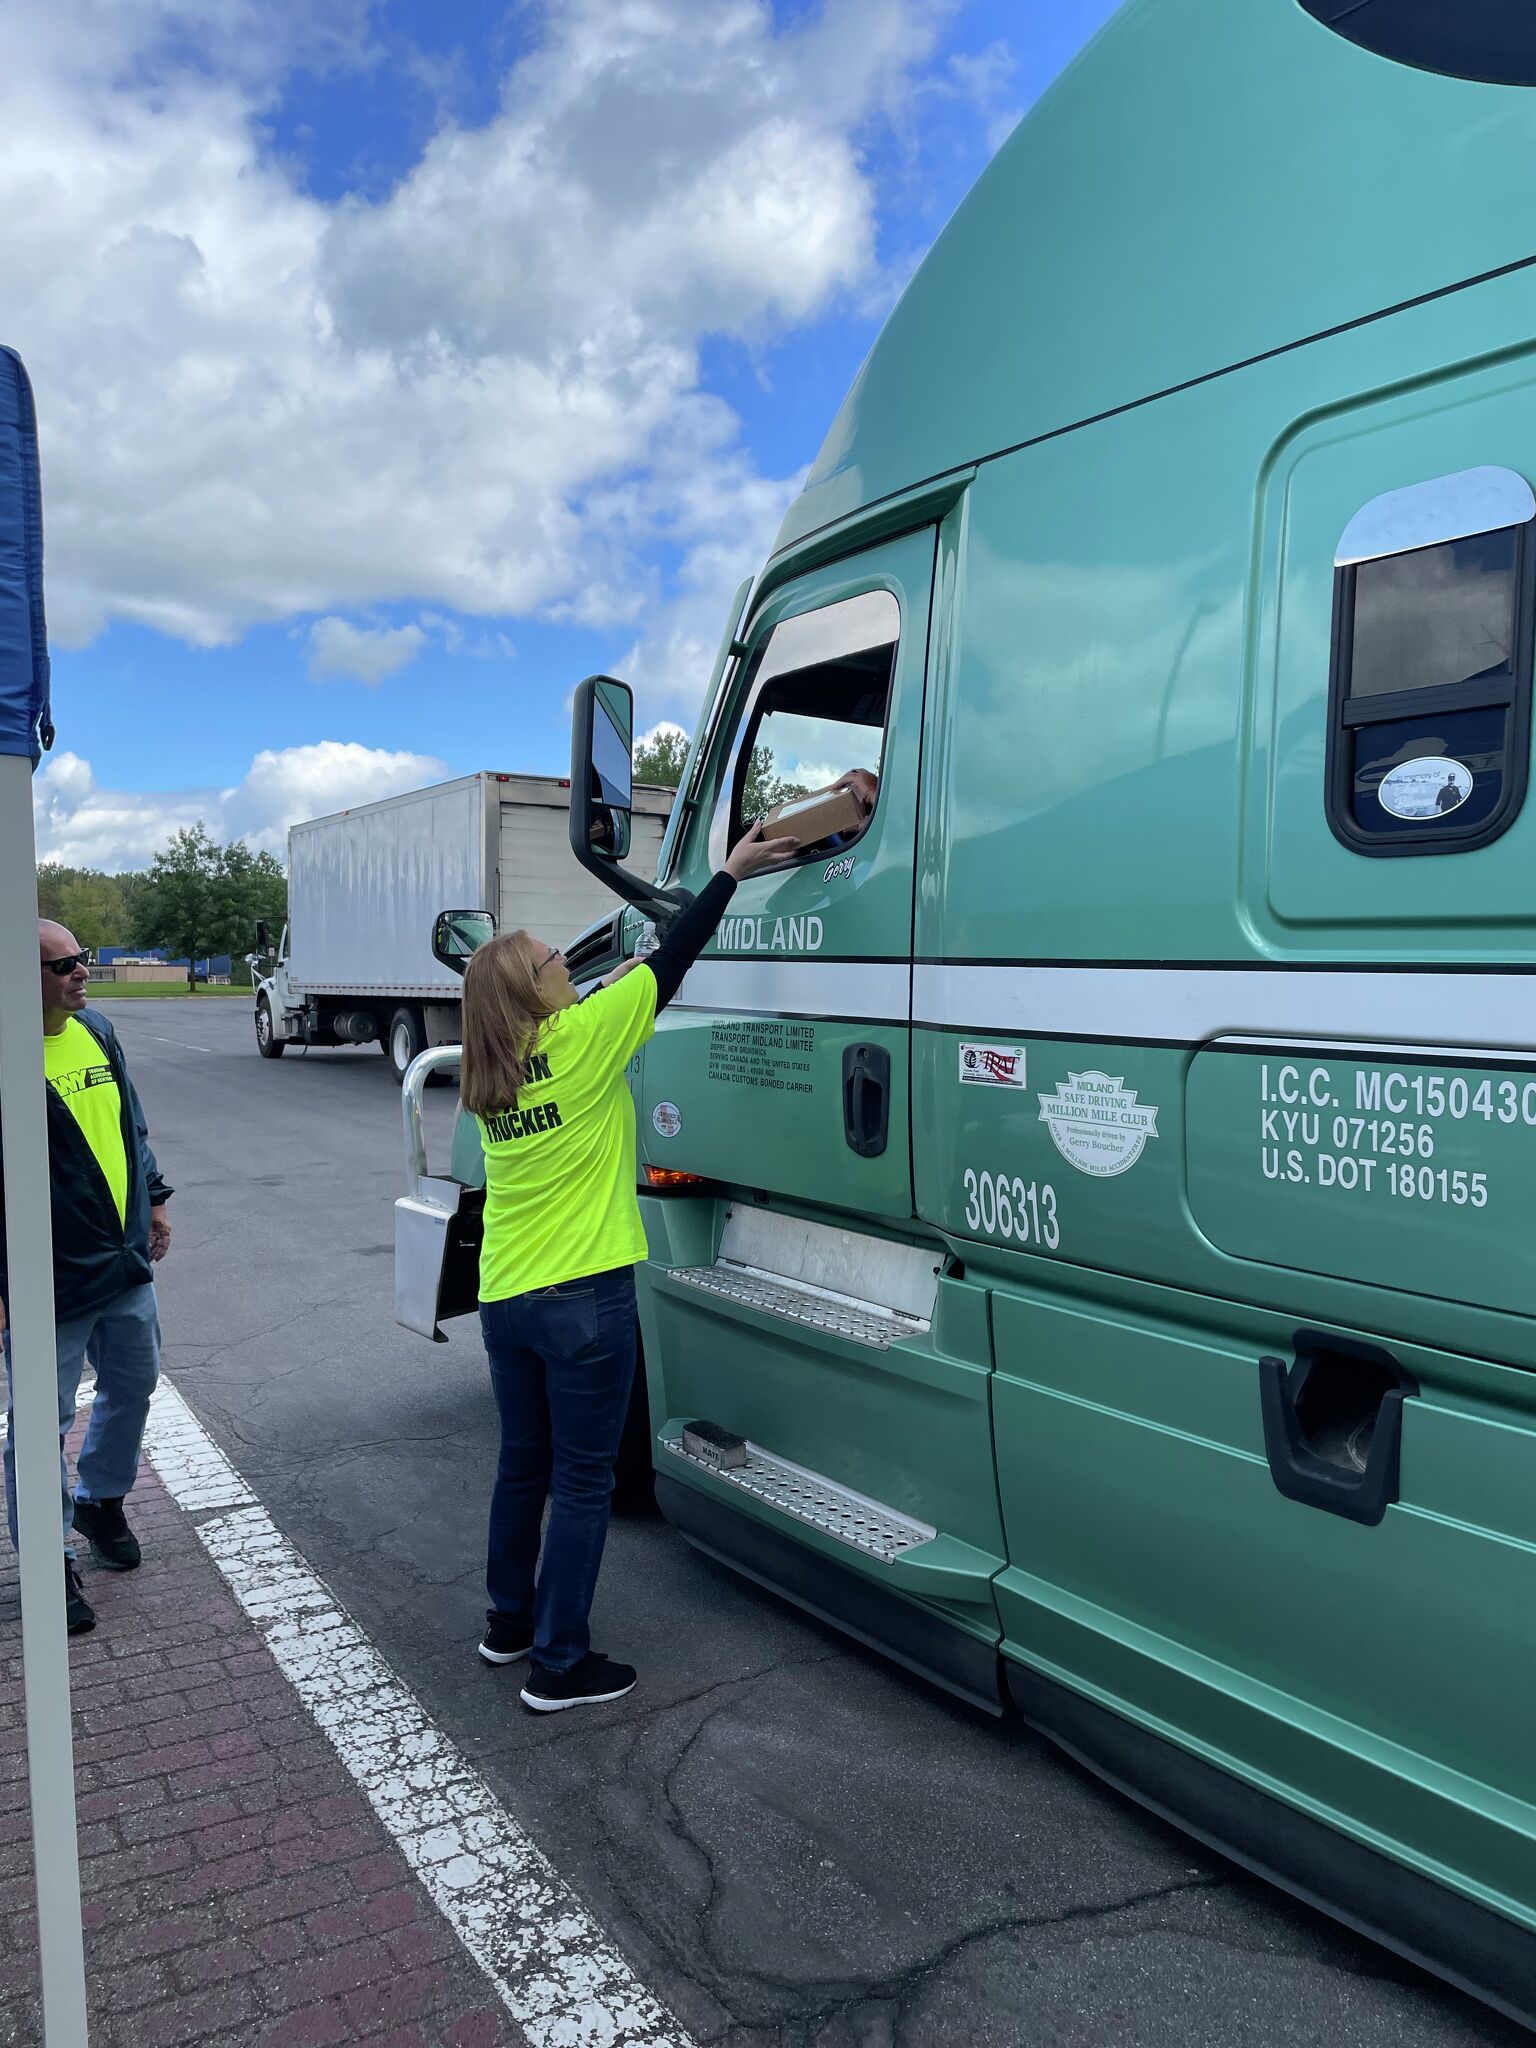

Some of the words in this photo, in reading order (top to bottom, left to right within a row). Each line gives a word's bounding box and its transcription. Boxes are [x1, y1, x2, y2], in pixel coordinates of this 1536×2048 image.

[717, 916, 824, 951] MIDLAND
[712, 1020, 741, 1032] MIDLAND
[742, 1022, 784, 1035] TRANSPORT
[786, 1026, 815, 1039] LIMITED
[712, 1031, 750, 1044] TRANSPORT
[752, 1035, 784, 1049] MIDLAND
[786, 1039, 814, 1052] LIMITEE
[730, 1054, 749, 1063] CANADA
[750, 1057, 760, 1065] AND
[761, 1058, 771, 1067] THE
[772, 1060, 791, 1069] UNITED
[792, 1062, 811, 1072] STATES
[708, 1070, 731, 1081] CANADA
[731, 1073, 759, 1086] CUSTOMS
[760, 1078, 785, 1090] BONDED
[786, 1081, 813, 1094] CARRIER
[1077, 1081, 1114, 1094] MIDLAND
[1261, 1064, 1339, 1108] I.C.C.
[1064, 1092, 1086, 1105] SAFE
[1088, 1095, 1127, 1109] DRIVING
[486, 1101, 563, 1144] TRUCKER
[1047, 1103, 1088, 1118] MILLION
[1091, 1109, 1118, 1122] MILE
[1120, 1112, 1148, 1126] CLUB
[1066, 1126, 1101, 1139] Professionally
[1261, 1108, 1320, 1145] KYU
[1332, 1116, 1434, 1158] 071256
[1069, 1137, 1090, 1149] Gerry
[1092, 1140, 1124, 1153] Boucher
[1065, 1147, 1088, 1169] MILLION
[1089, 1164, 1108, 1172] MILES
[1262, 1147, 1310, 1183] U.S.
[1318, 1153, 1377, 1192] DOT
[1386, 1162, 1488, 1208] 180155
[964, 1168, 1060, 1250] 306313
